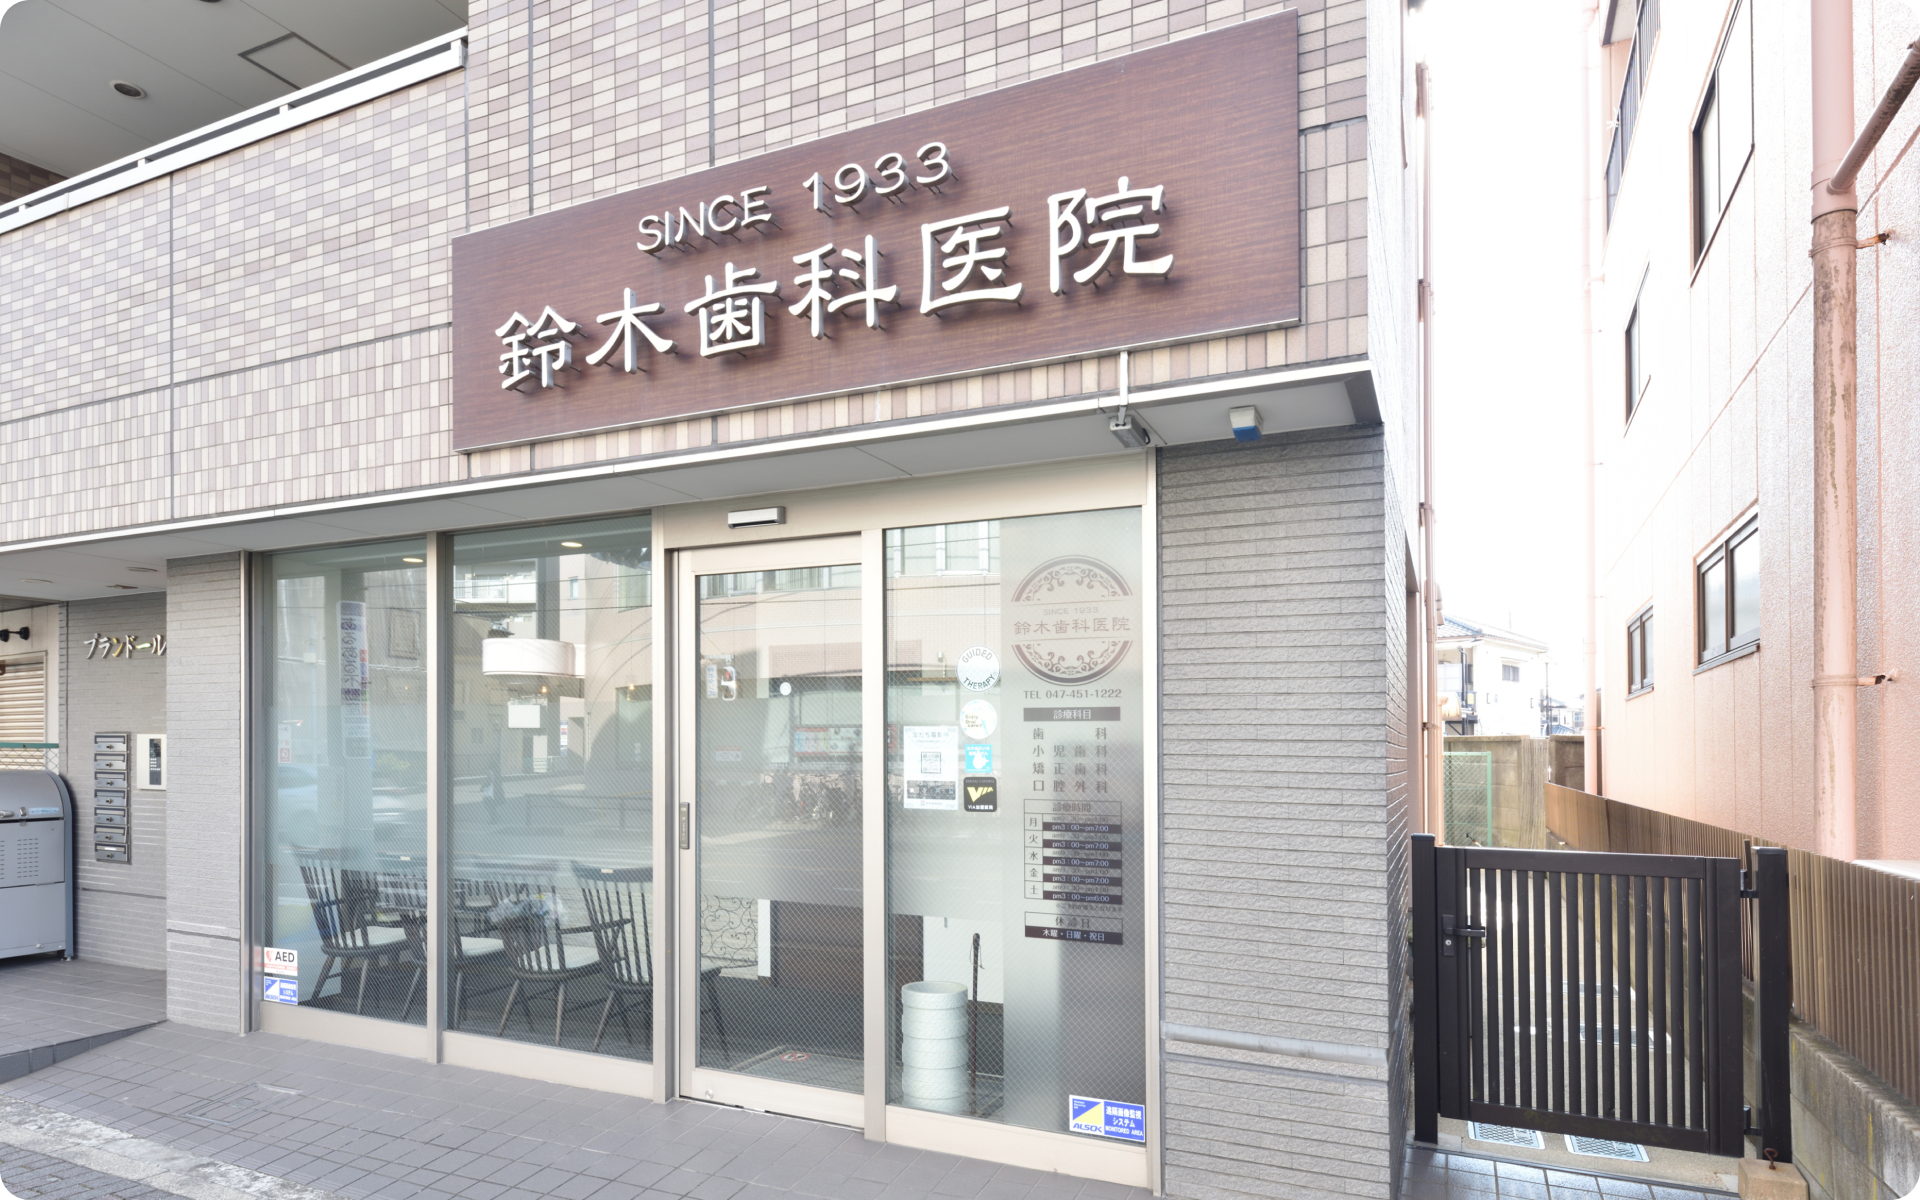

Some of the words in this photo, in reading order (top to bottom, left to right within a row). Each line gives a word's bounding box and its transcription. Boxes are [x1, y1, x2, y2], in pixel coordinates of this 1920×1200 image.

[637, 186, 771, 252] SINCE
[803, 142, 954, 211] 1933
[495, 176, 1174, 390] 鈴木歯科医院
[1043, 608, 1069, 616] SINCE
[1073, 606, 1099, 614] 1933
[1013, 617, 1131, 635] 鈴木歯科医院
[961, 648, 993, 663] GUIDED
[963, 673, 995, 690] THERAPY
[1023, 690, 1042, 699] TEL
[1045, 688, 1122, 699] 047-451-1222
[1053, 709, 1092, 720] 診療科目
[1033, 745, 1107, 758] 小児歯科
[1033, 762, 1107, 775] 矯正歯科
[1033, 780, 1107, 793] 口腔外科
[1029, 817, 1037, 827] 月
[1029, 834, 1038, 844] 火
[1029, 851, 1038, 861] 水
[1029, 868, 1038, 878] 金
[1029, 885, 1038, 895] 土
[1055, 916, 1090, 928] 休診日
[275, 951, 295, 962] AED
[1073, 1123, 1102, 1132] ALSOK
[1113, 1117, 1135, 1128] システム
